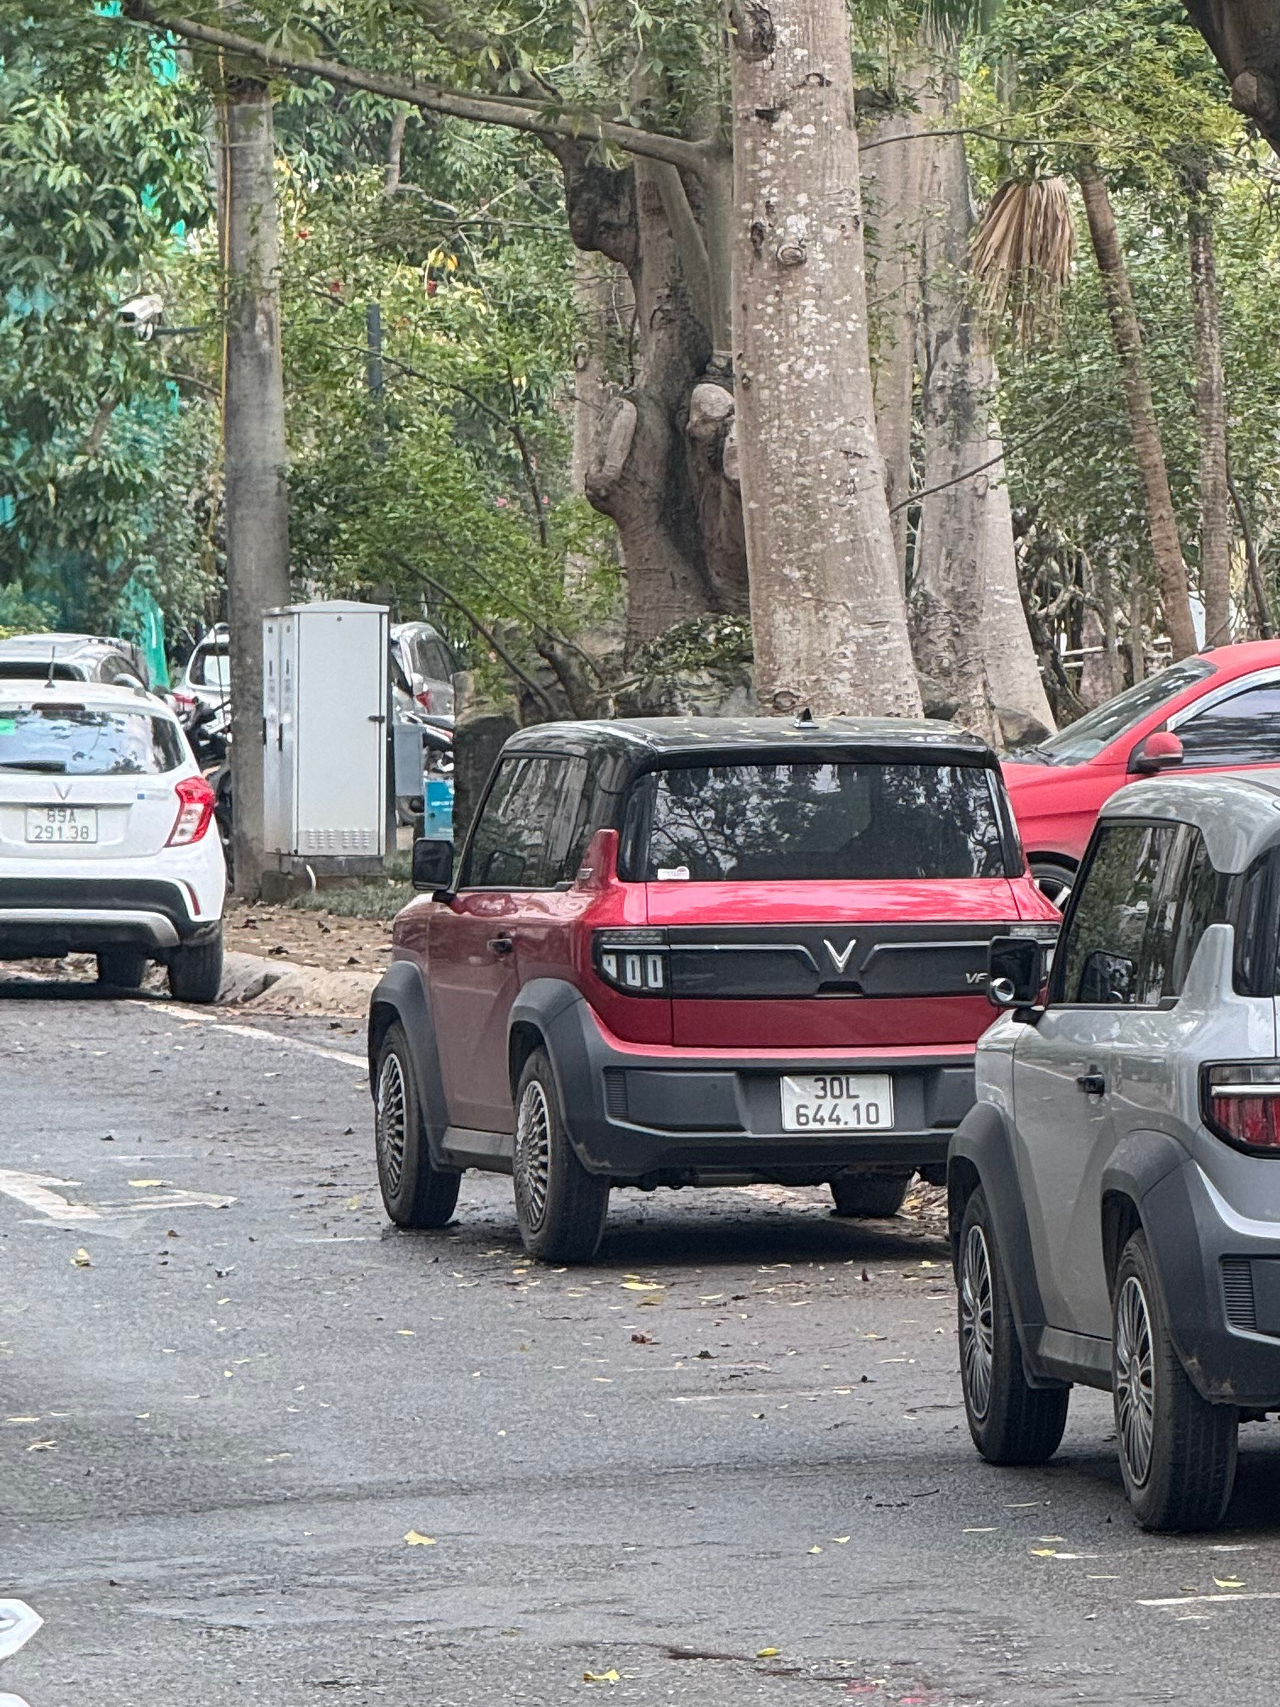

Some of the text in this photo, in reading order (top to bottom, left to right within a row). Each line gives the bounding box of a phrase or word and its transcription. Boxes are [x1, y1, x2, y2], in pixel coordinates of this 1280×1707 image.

[34, 825, 90, 840] 291.38
[965, 972, 990, 984] VF
[813, 1076, 860, 1100] 30L
[795, 1102, 880, 1127] 644.10
